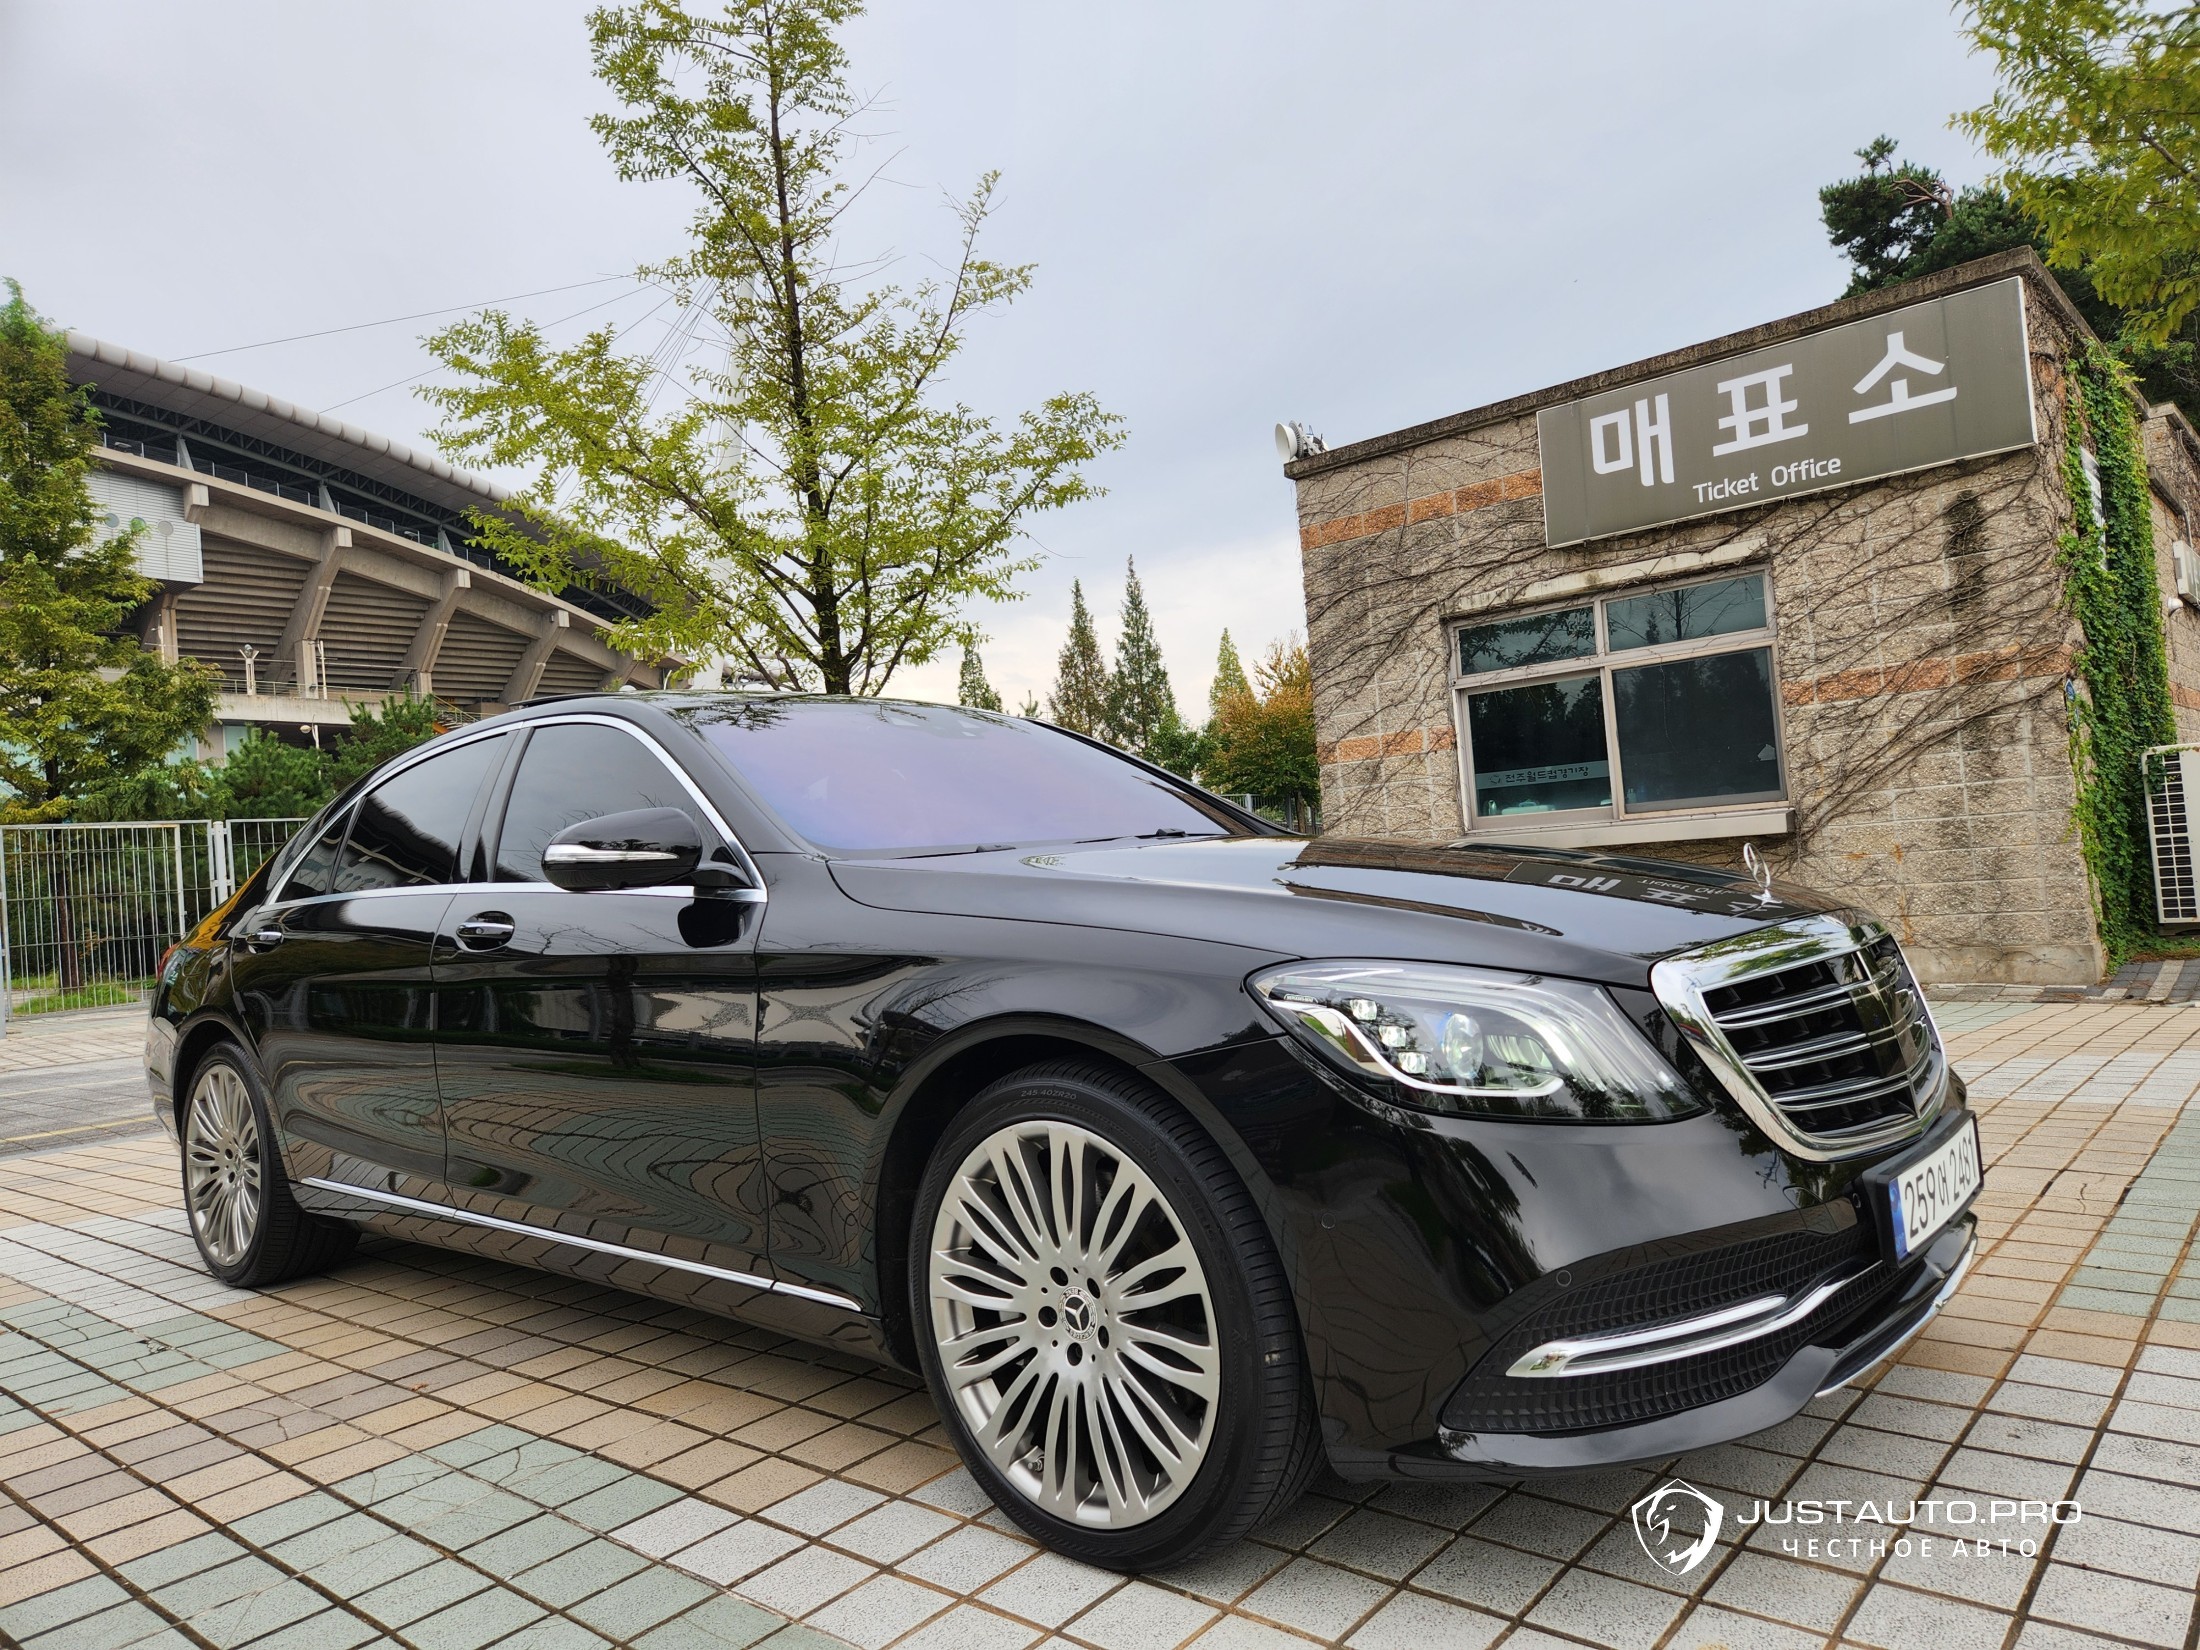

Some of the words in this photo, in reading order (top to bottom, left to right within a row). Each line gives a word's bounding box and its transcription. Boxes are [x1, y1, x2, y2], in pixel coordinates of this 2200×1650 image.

[1693, 471, 1760, 504] Ticket
[1771, 456, 1842, 488] Office
[1505, 766, 1589, 784] 전주월드컵경기장
